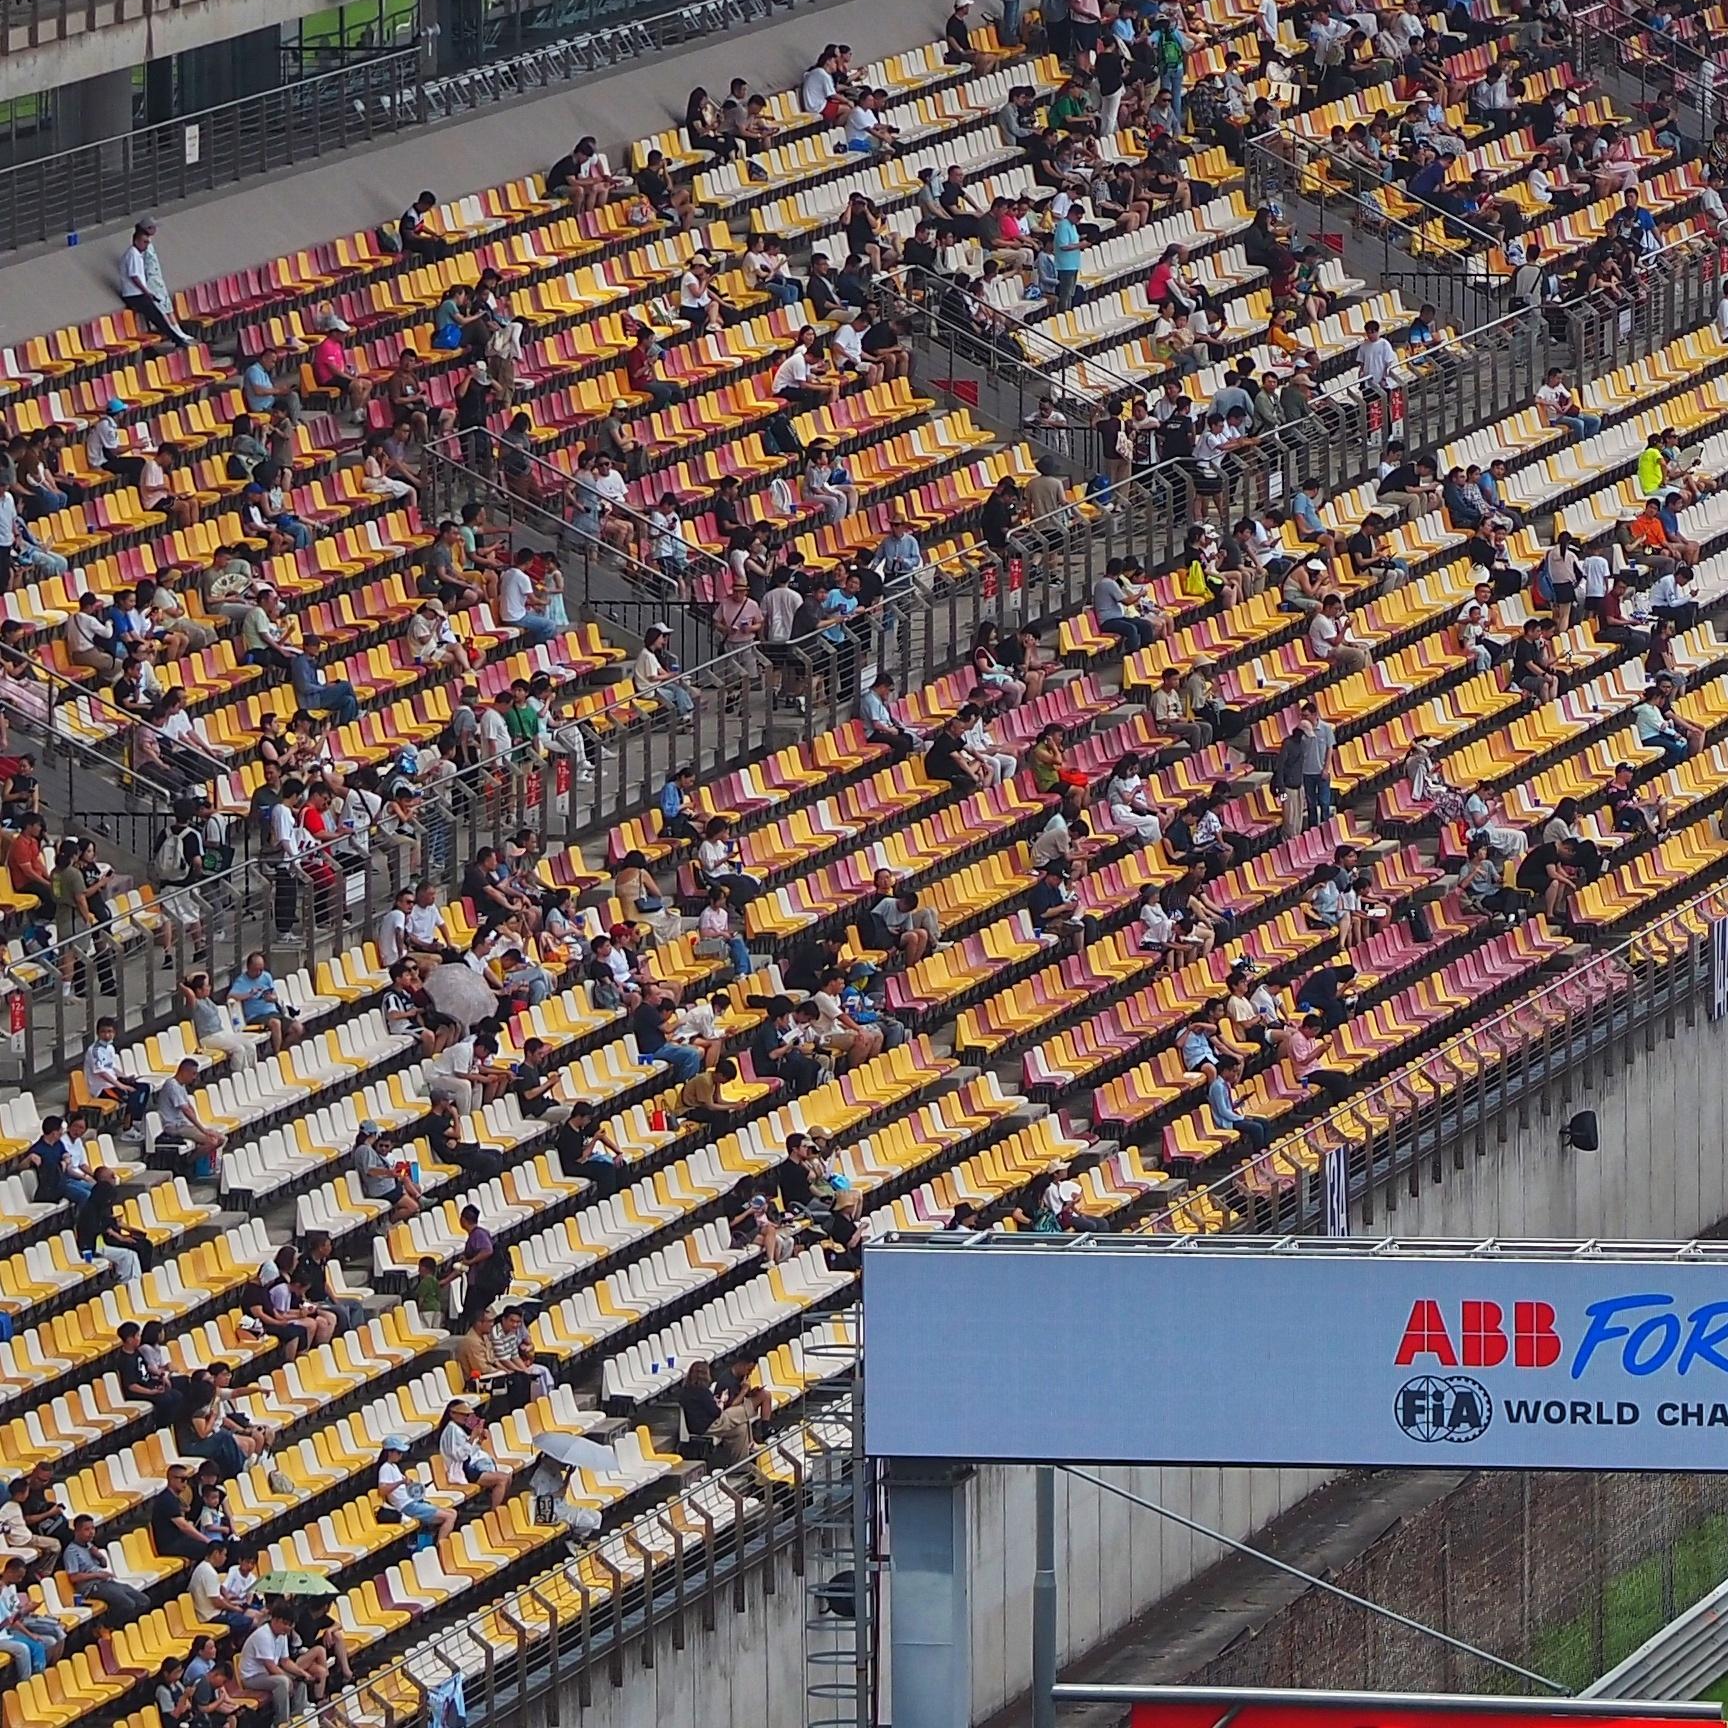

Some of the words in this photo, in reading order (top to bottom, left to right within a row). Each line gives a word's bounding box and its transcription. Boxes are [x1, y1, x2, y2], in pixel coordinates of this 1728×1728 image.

[1326, 1144, 1347, 1237] 13A
[1394, 1299, 1562, 1368] ABB
[1503, 1399, 1640, 1427] WORLD
